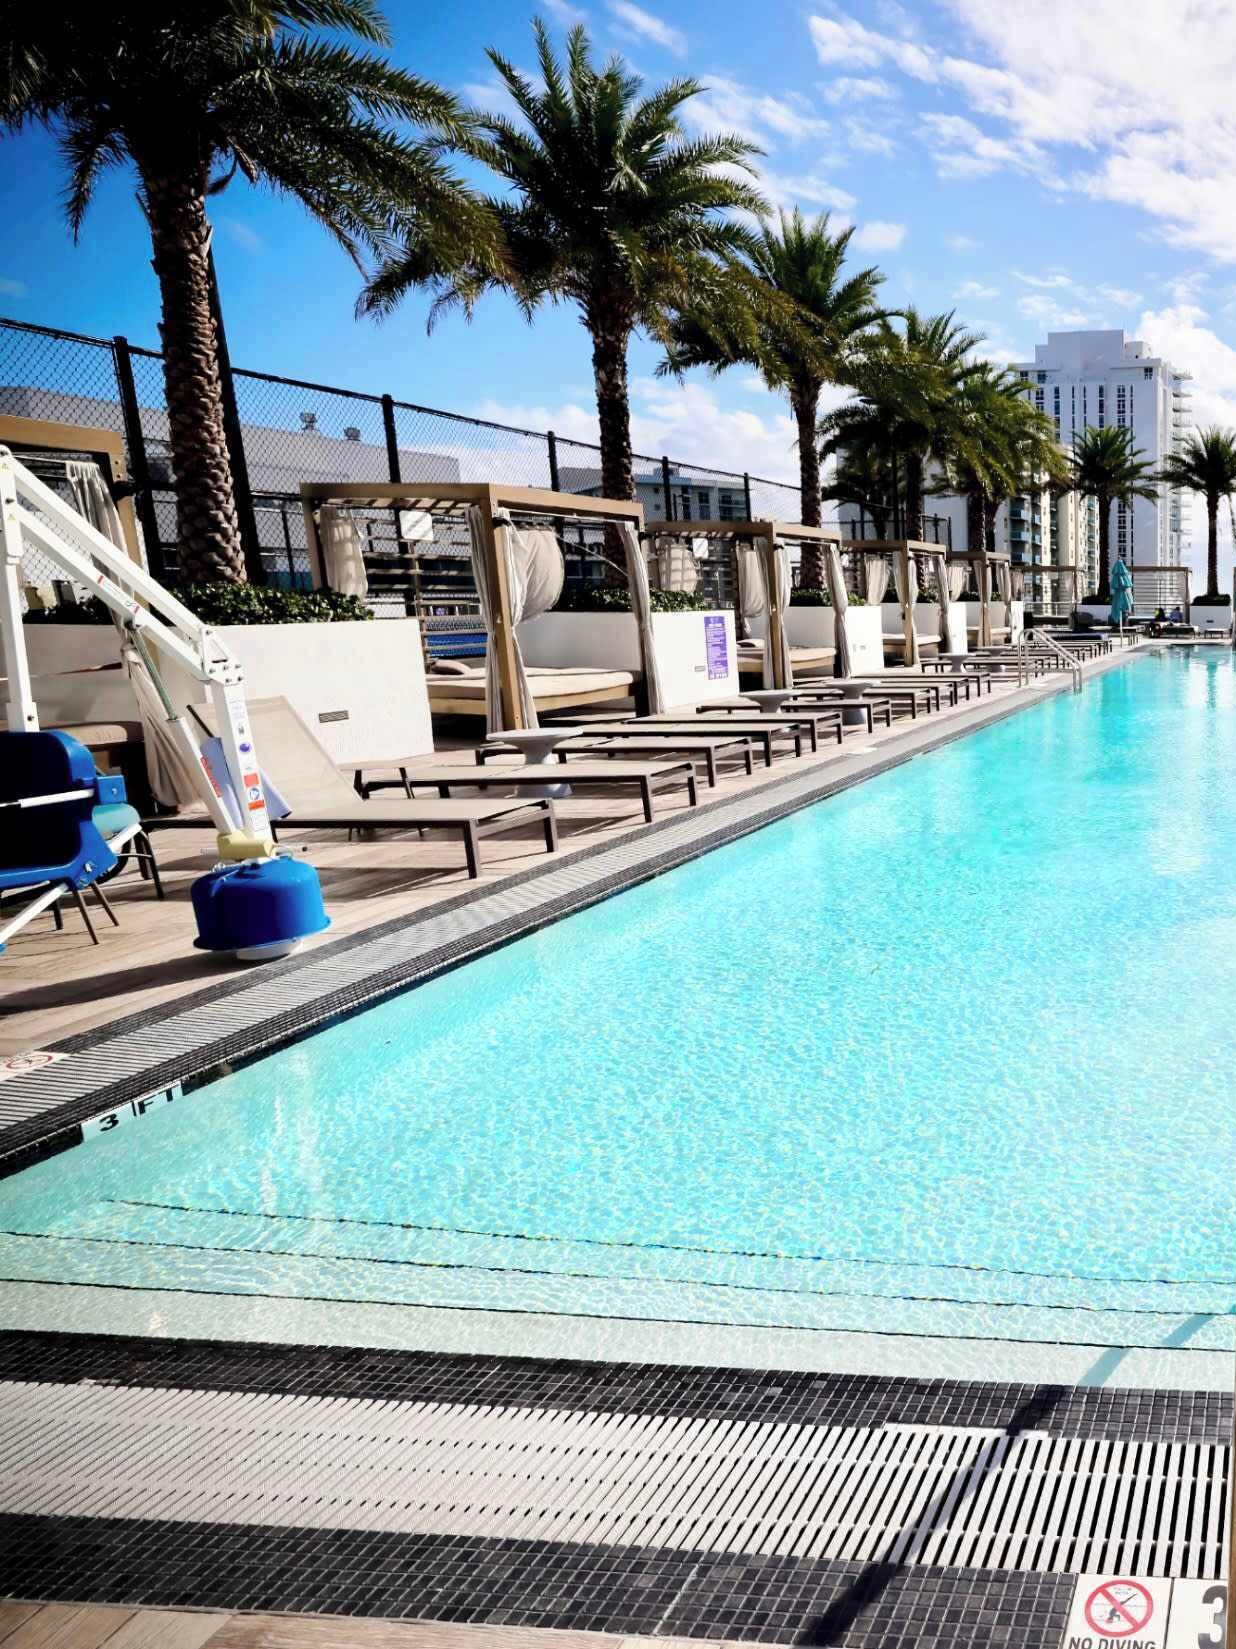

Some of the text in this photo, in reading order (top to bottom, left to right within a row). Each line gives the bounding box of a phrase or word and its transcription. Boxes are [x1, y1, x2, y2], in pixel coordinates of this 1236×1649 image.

[99, 1084, 180, 1132] 3 FT
[1198, 1584, 1227, 1649] 3
[1068, 1636, 1157, 1649] NO DIVING
